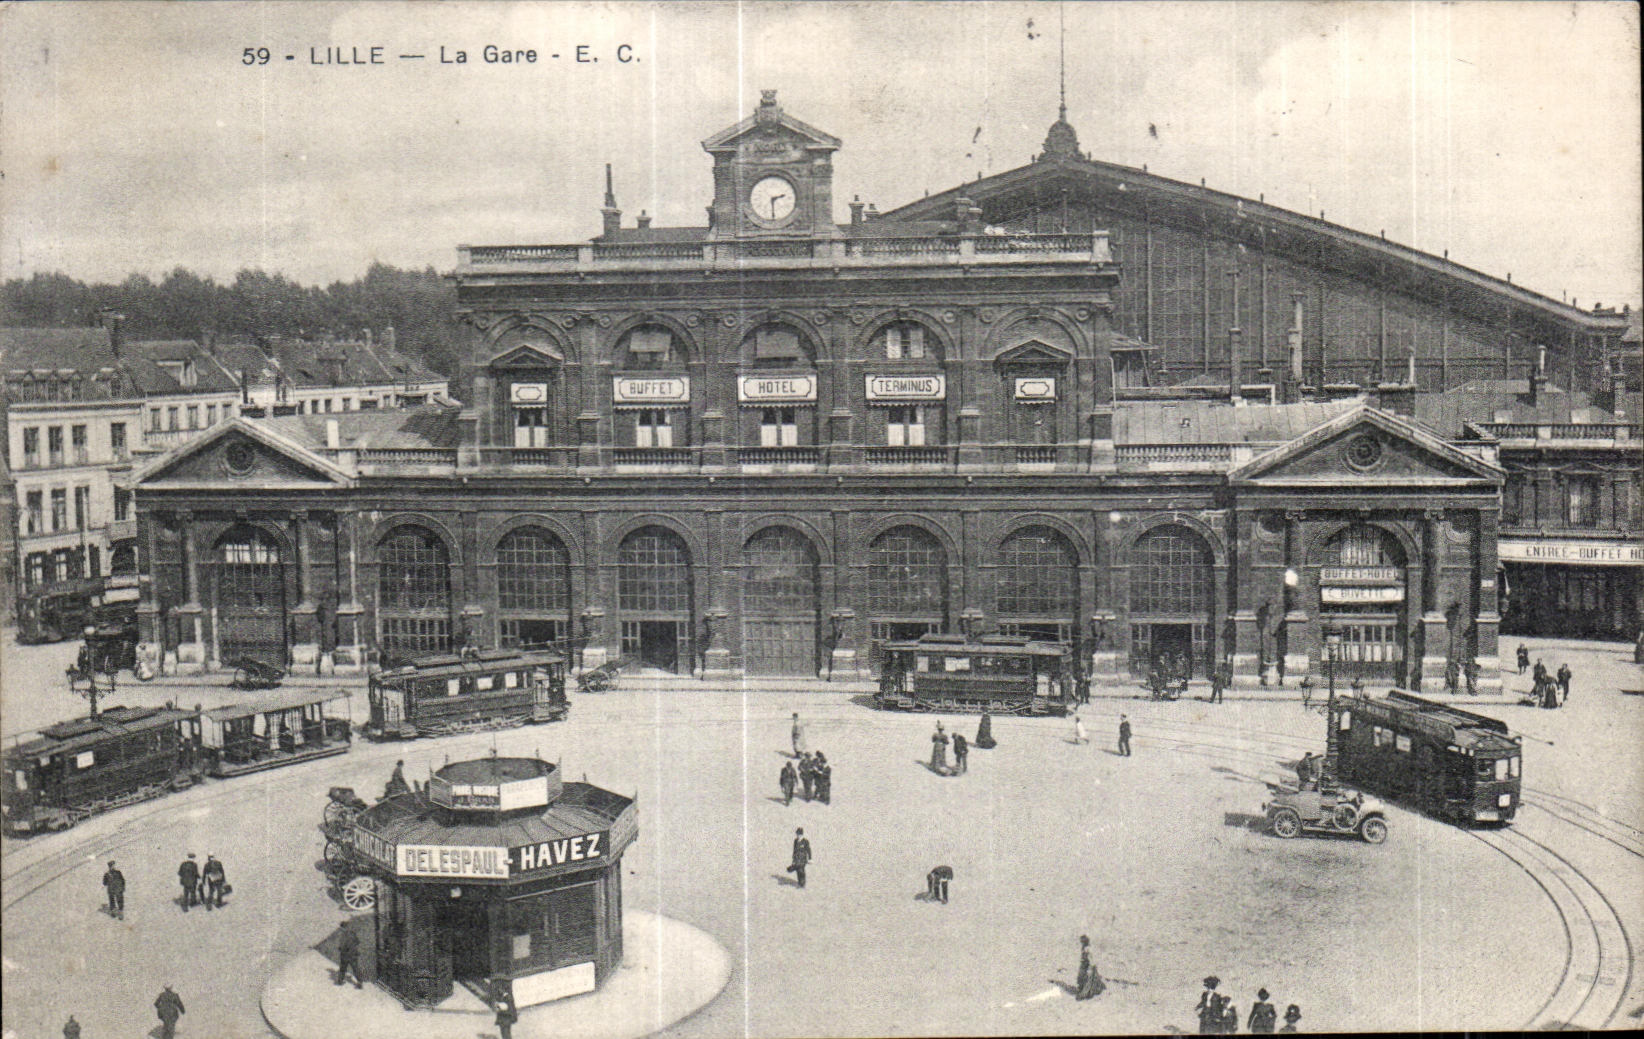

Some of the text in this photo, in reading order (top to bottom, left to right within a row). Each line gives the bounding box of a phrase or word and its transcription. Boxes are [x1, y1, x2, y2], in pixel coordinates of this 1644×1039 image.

[629, 381, 674, 395] BUFFET
[758, 380, 797, 394] HOTEL
[878, 379, 933, 393] TERMINUS
[520, 833, 601, 871] HAVEZ
